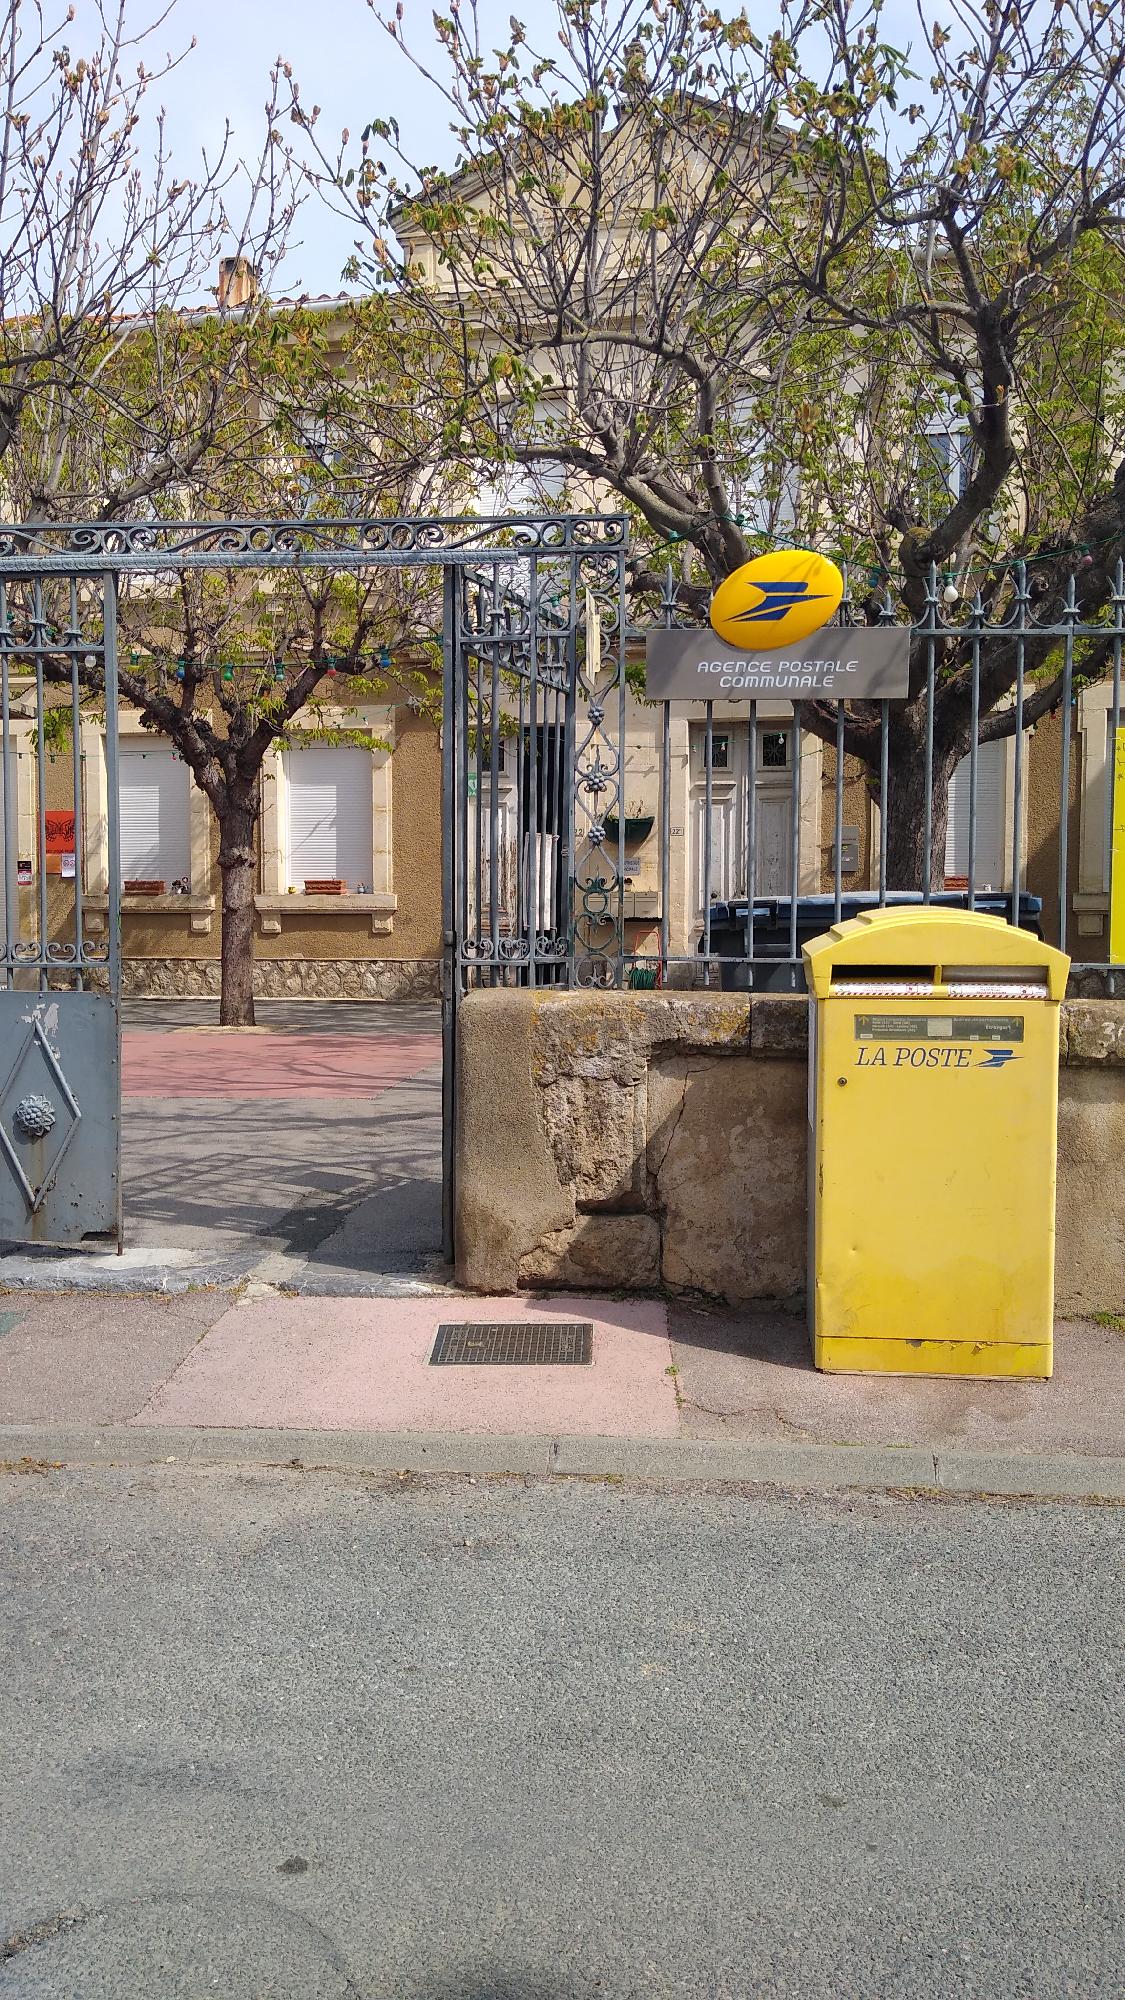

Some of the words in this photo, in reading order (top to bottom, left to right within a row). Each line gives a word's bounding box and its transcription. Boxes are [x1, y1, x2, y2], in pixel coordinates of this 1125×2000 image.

[697, 661, 771, 673] AGENCE
[778, 660, 858, 672] POSTALE
[719, 675, 834, 688] COMMUNALE
[855, 1047, 887, 1066] LA
[893, 1047, 972, 1067] POSTE
